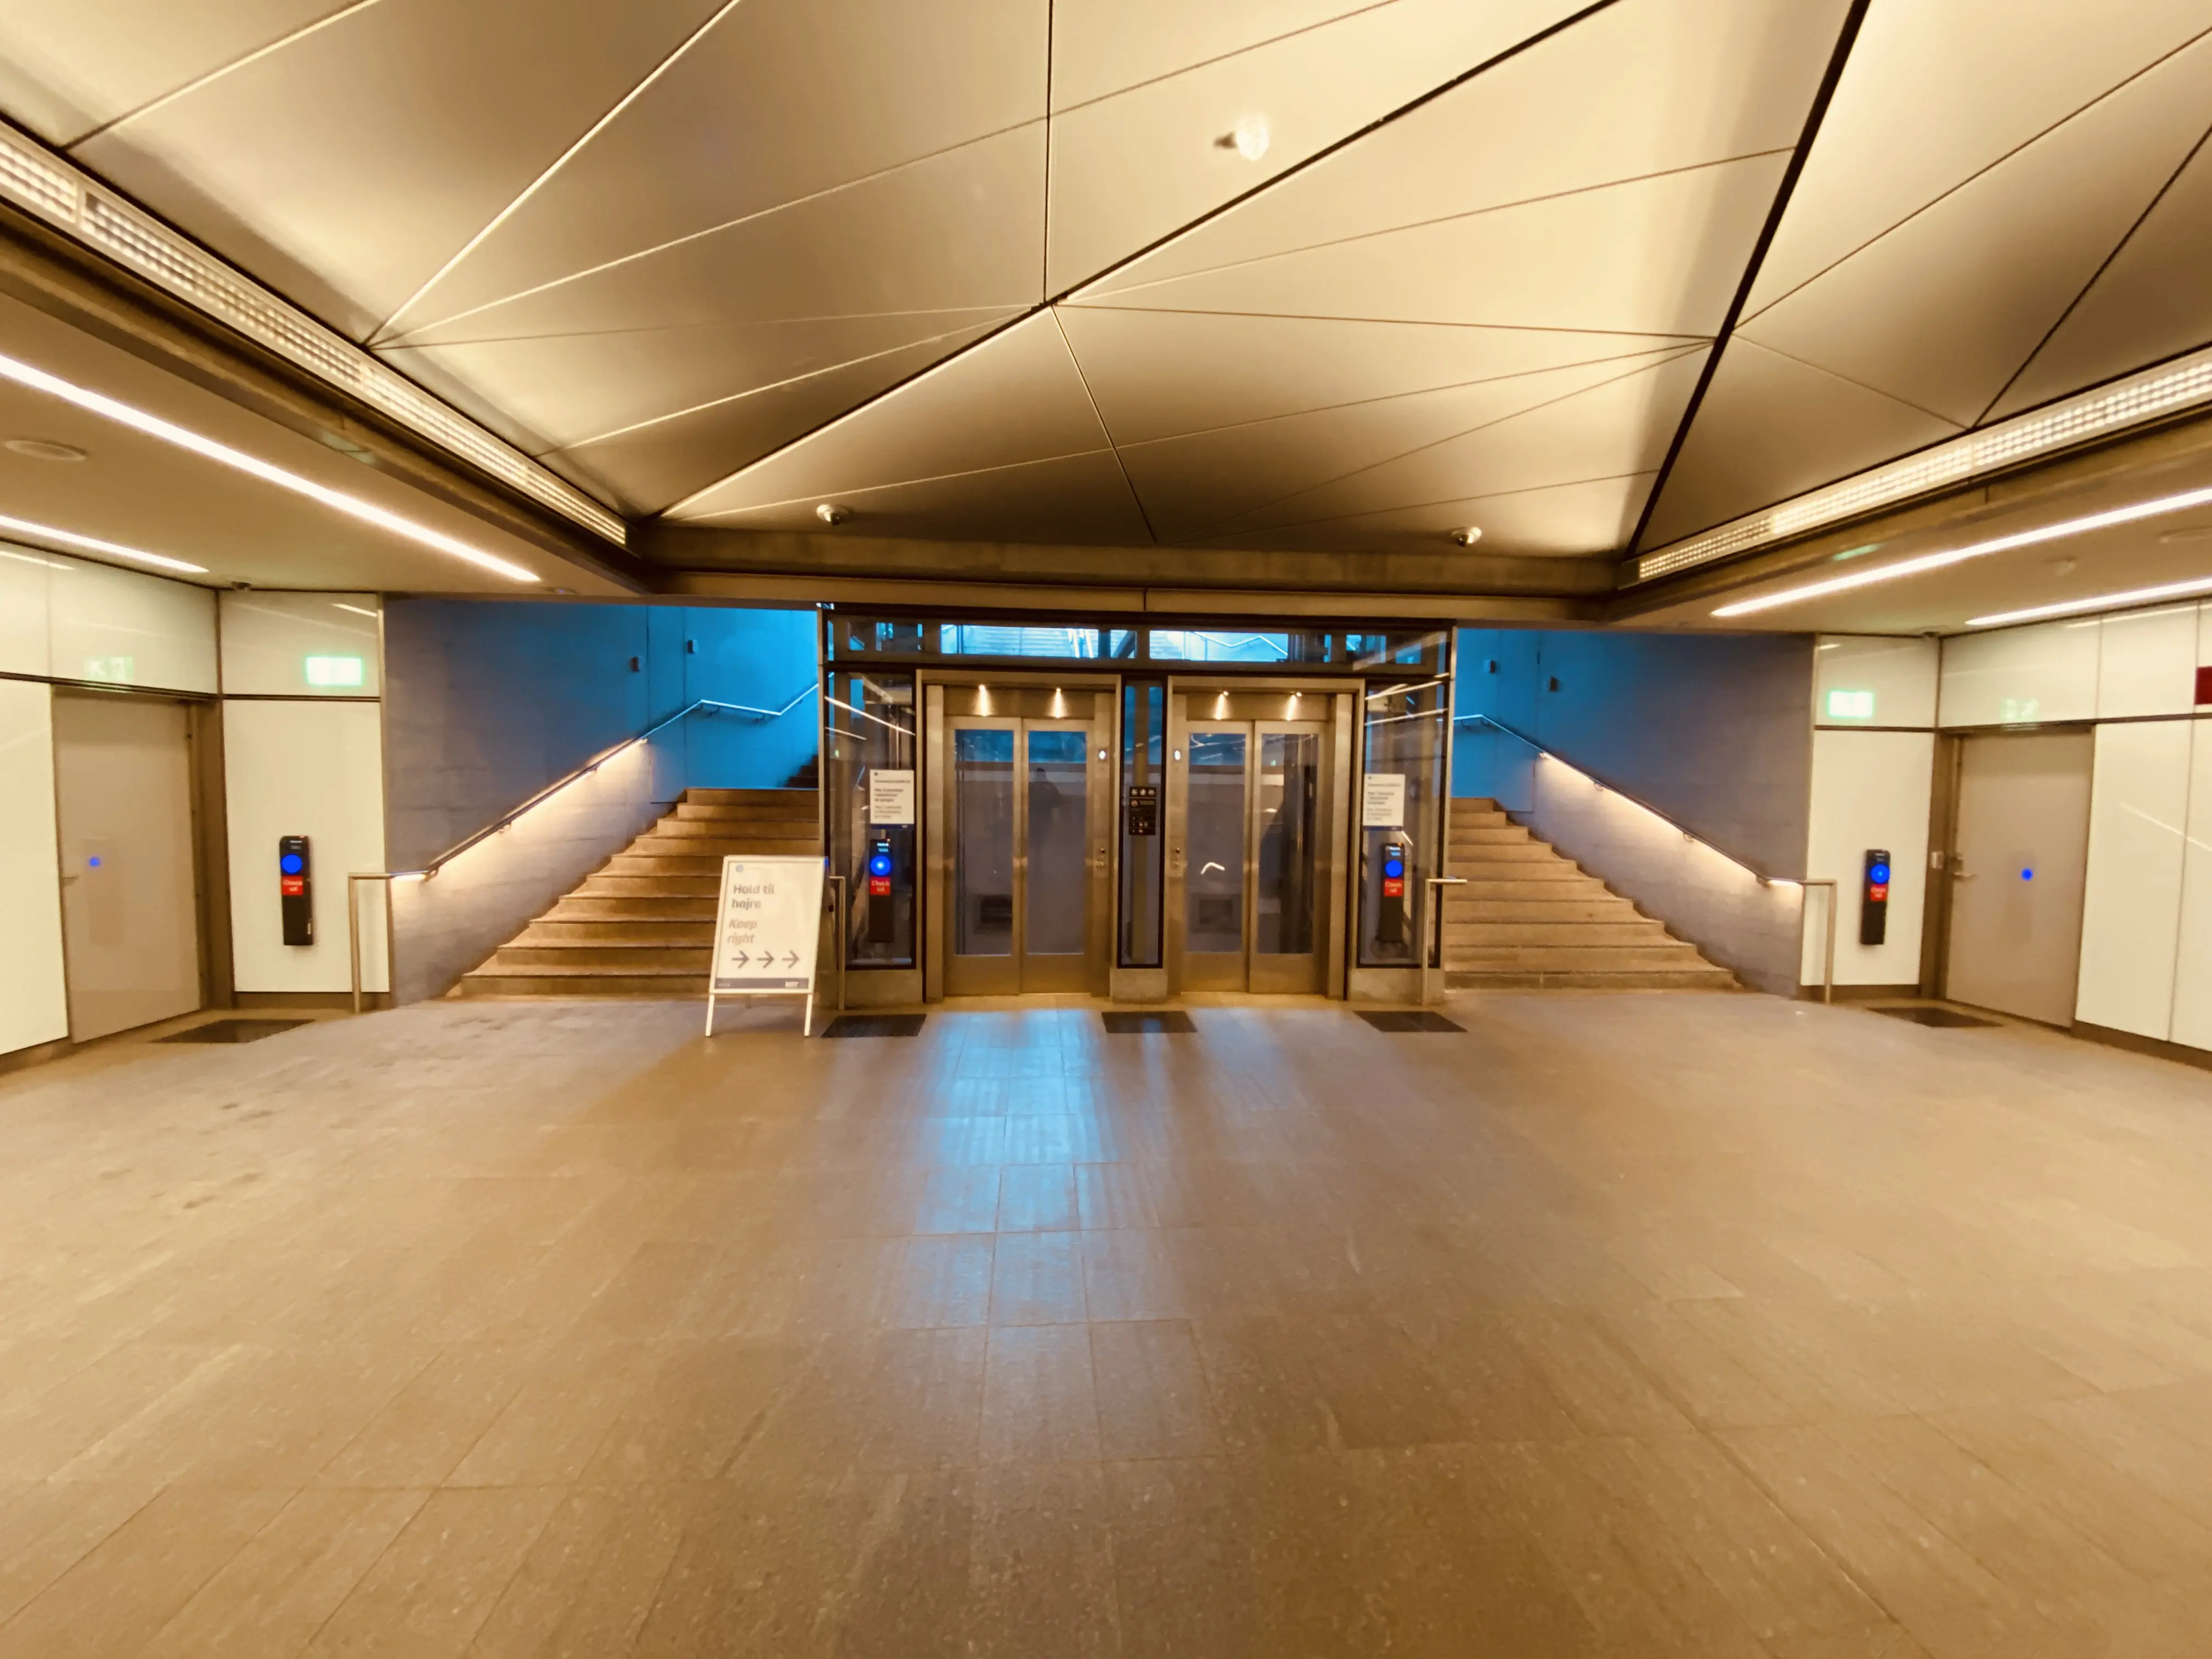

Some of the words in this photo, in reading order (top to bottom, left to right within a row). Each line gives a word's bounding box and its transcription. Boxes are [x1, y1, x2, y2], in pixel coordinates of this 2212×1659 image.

[733, 884, 760, 894] Hold
[763, 883, 775, 895] til
[729, 918, 758, 931] Keep
[727, 932, 755, 945] right
